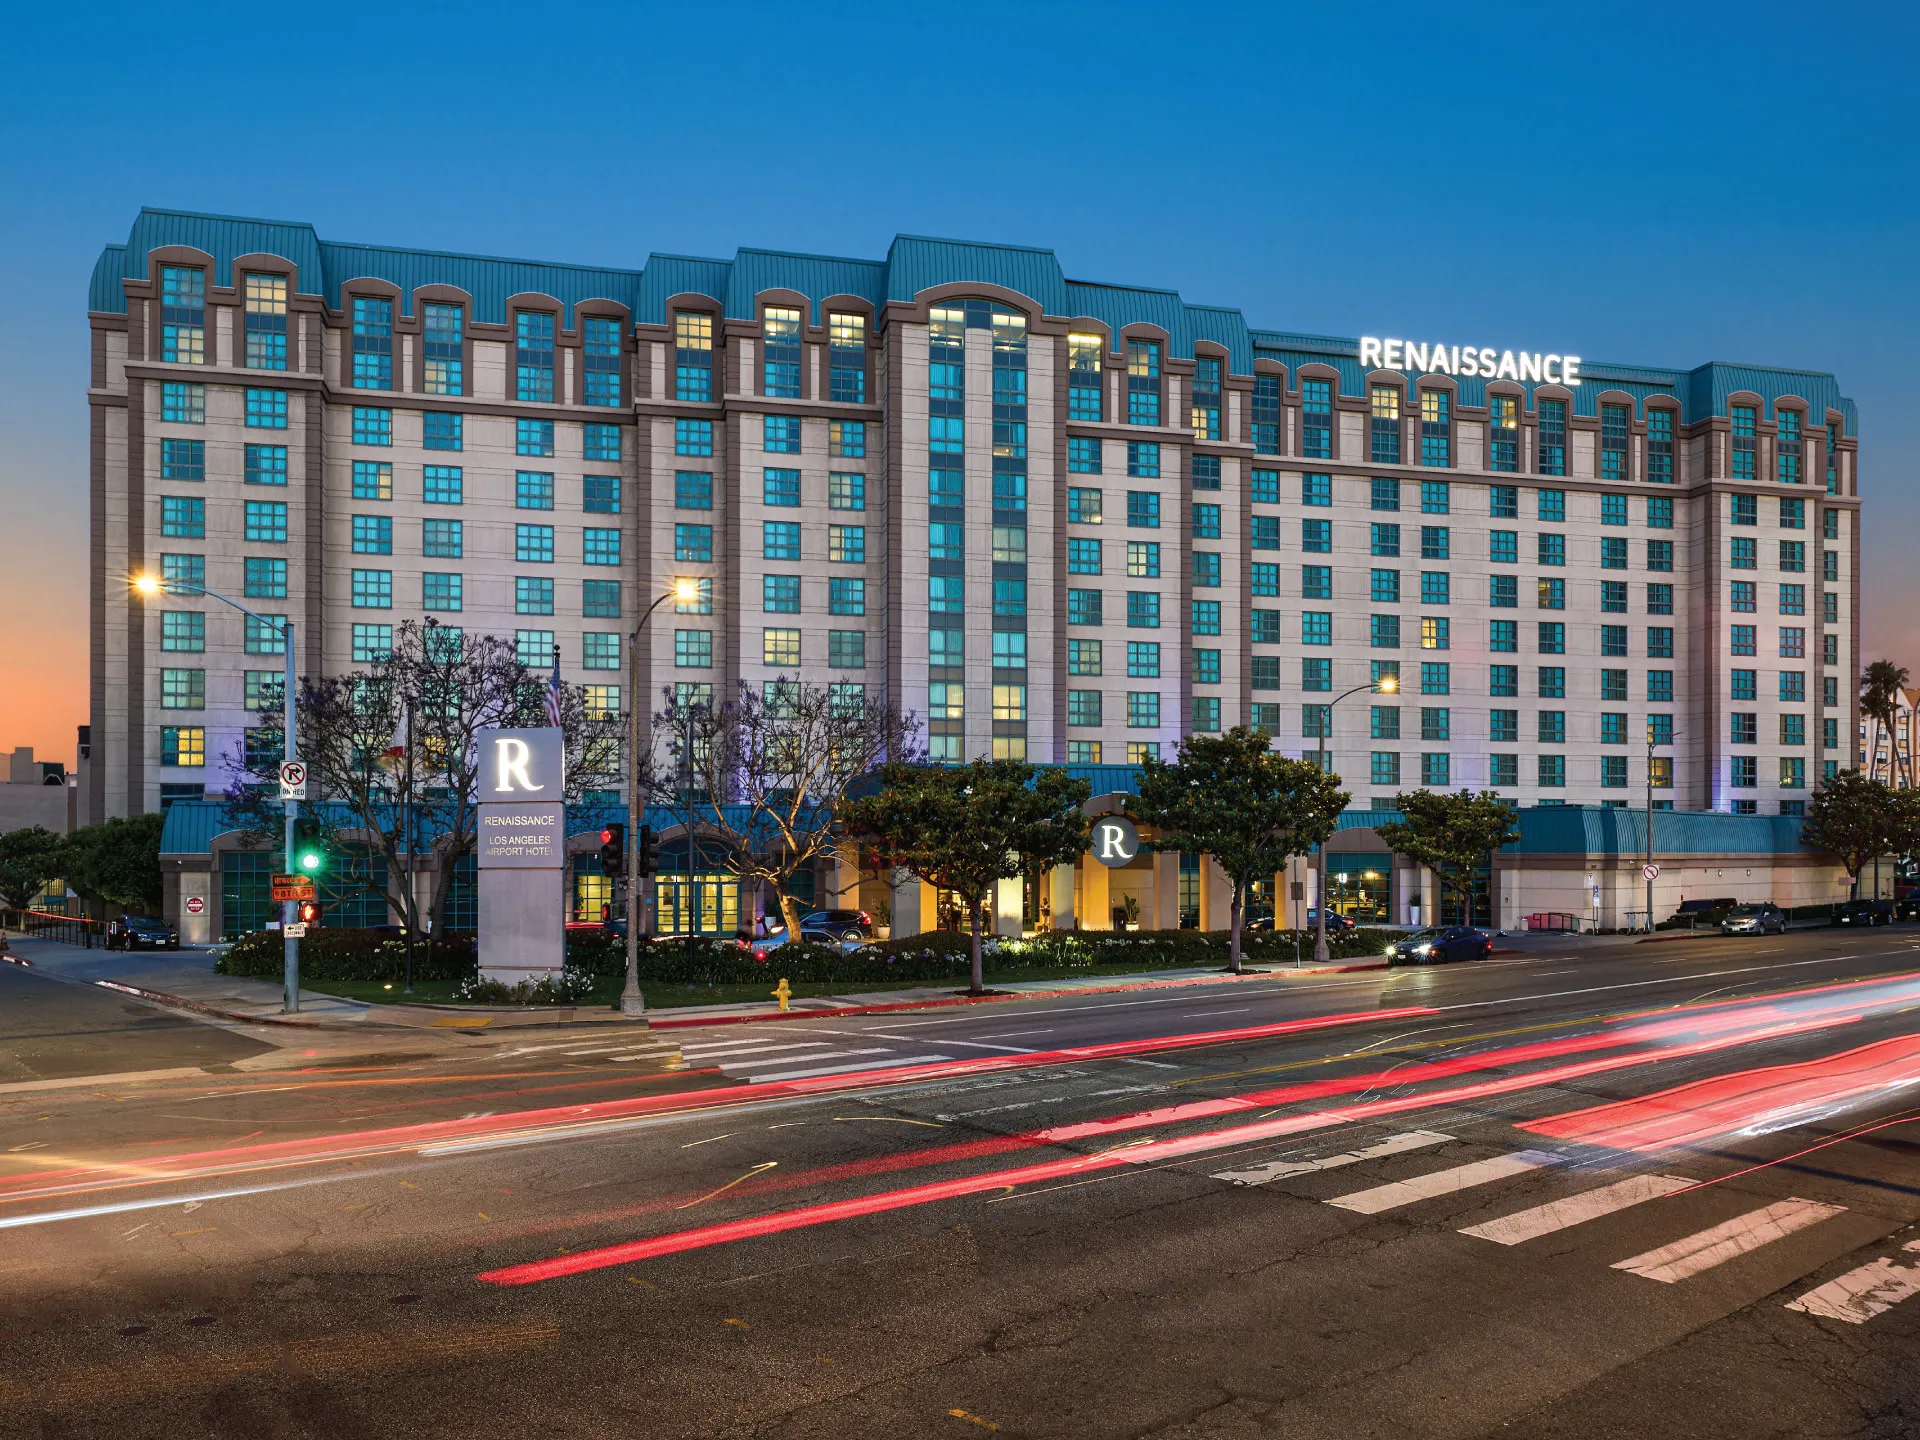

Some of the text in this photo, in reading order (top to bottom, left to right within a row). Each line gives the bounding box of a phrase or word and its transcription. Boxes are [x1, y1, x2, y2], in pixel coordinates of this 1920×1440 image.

[1360, 336, 1581, 386] RENAISSANCE
[494, 738, 545, 792] R
[282, 788, 291, 796] ON
[484, 815, 555, 826] RENAISSANCE
[489, 835, 551, 845] LOS ANGELES
[1100, 825, 1134, 859] R
[485, 847, 557, 856] AIRPORT HOTEL
